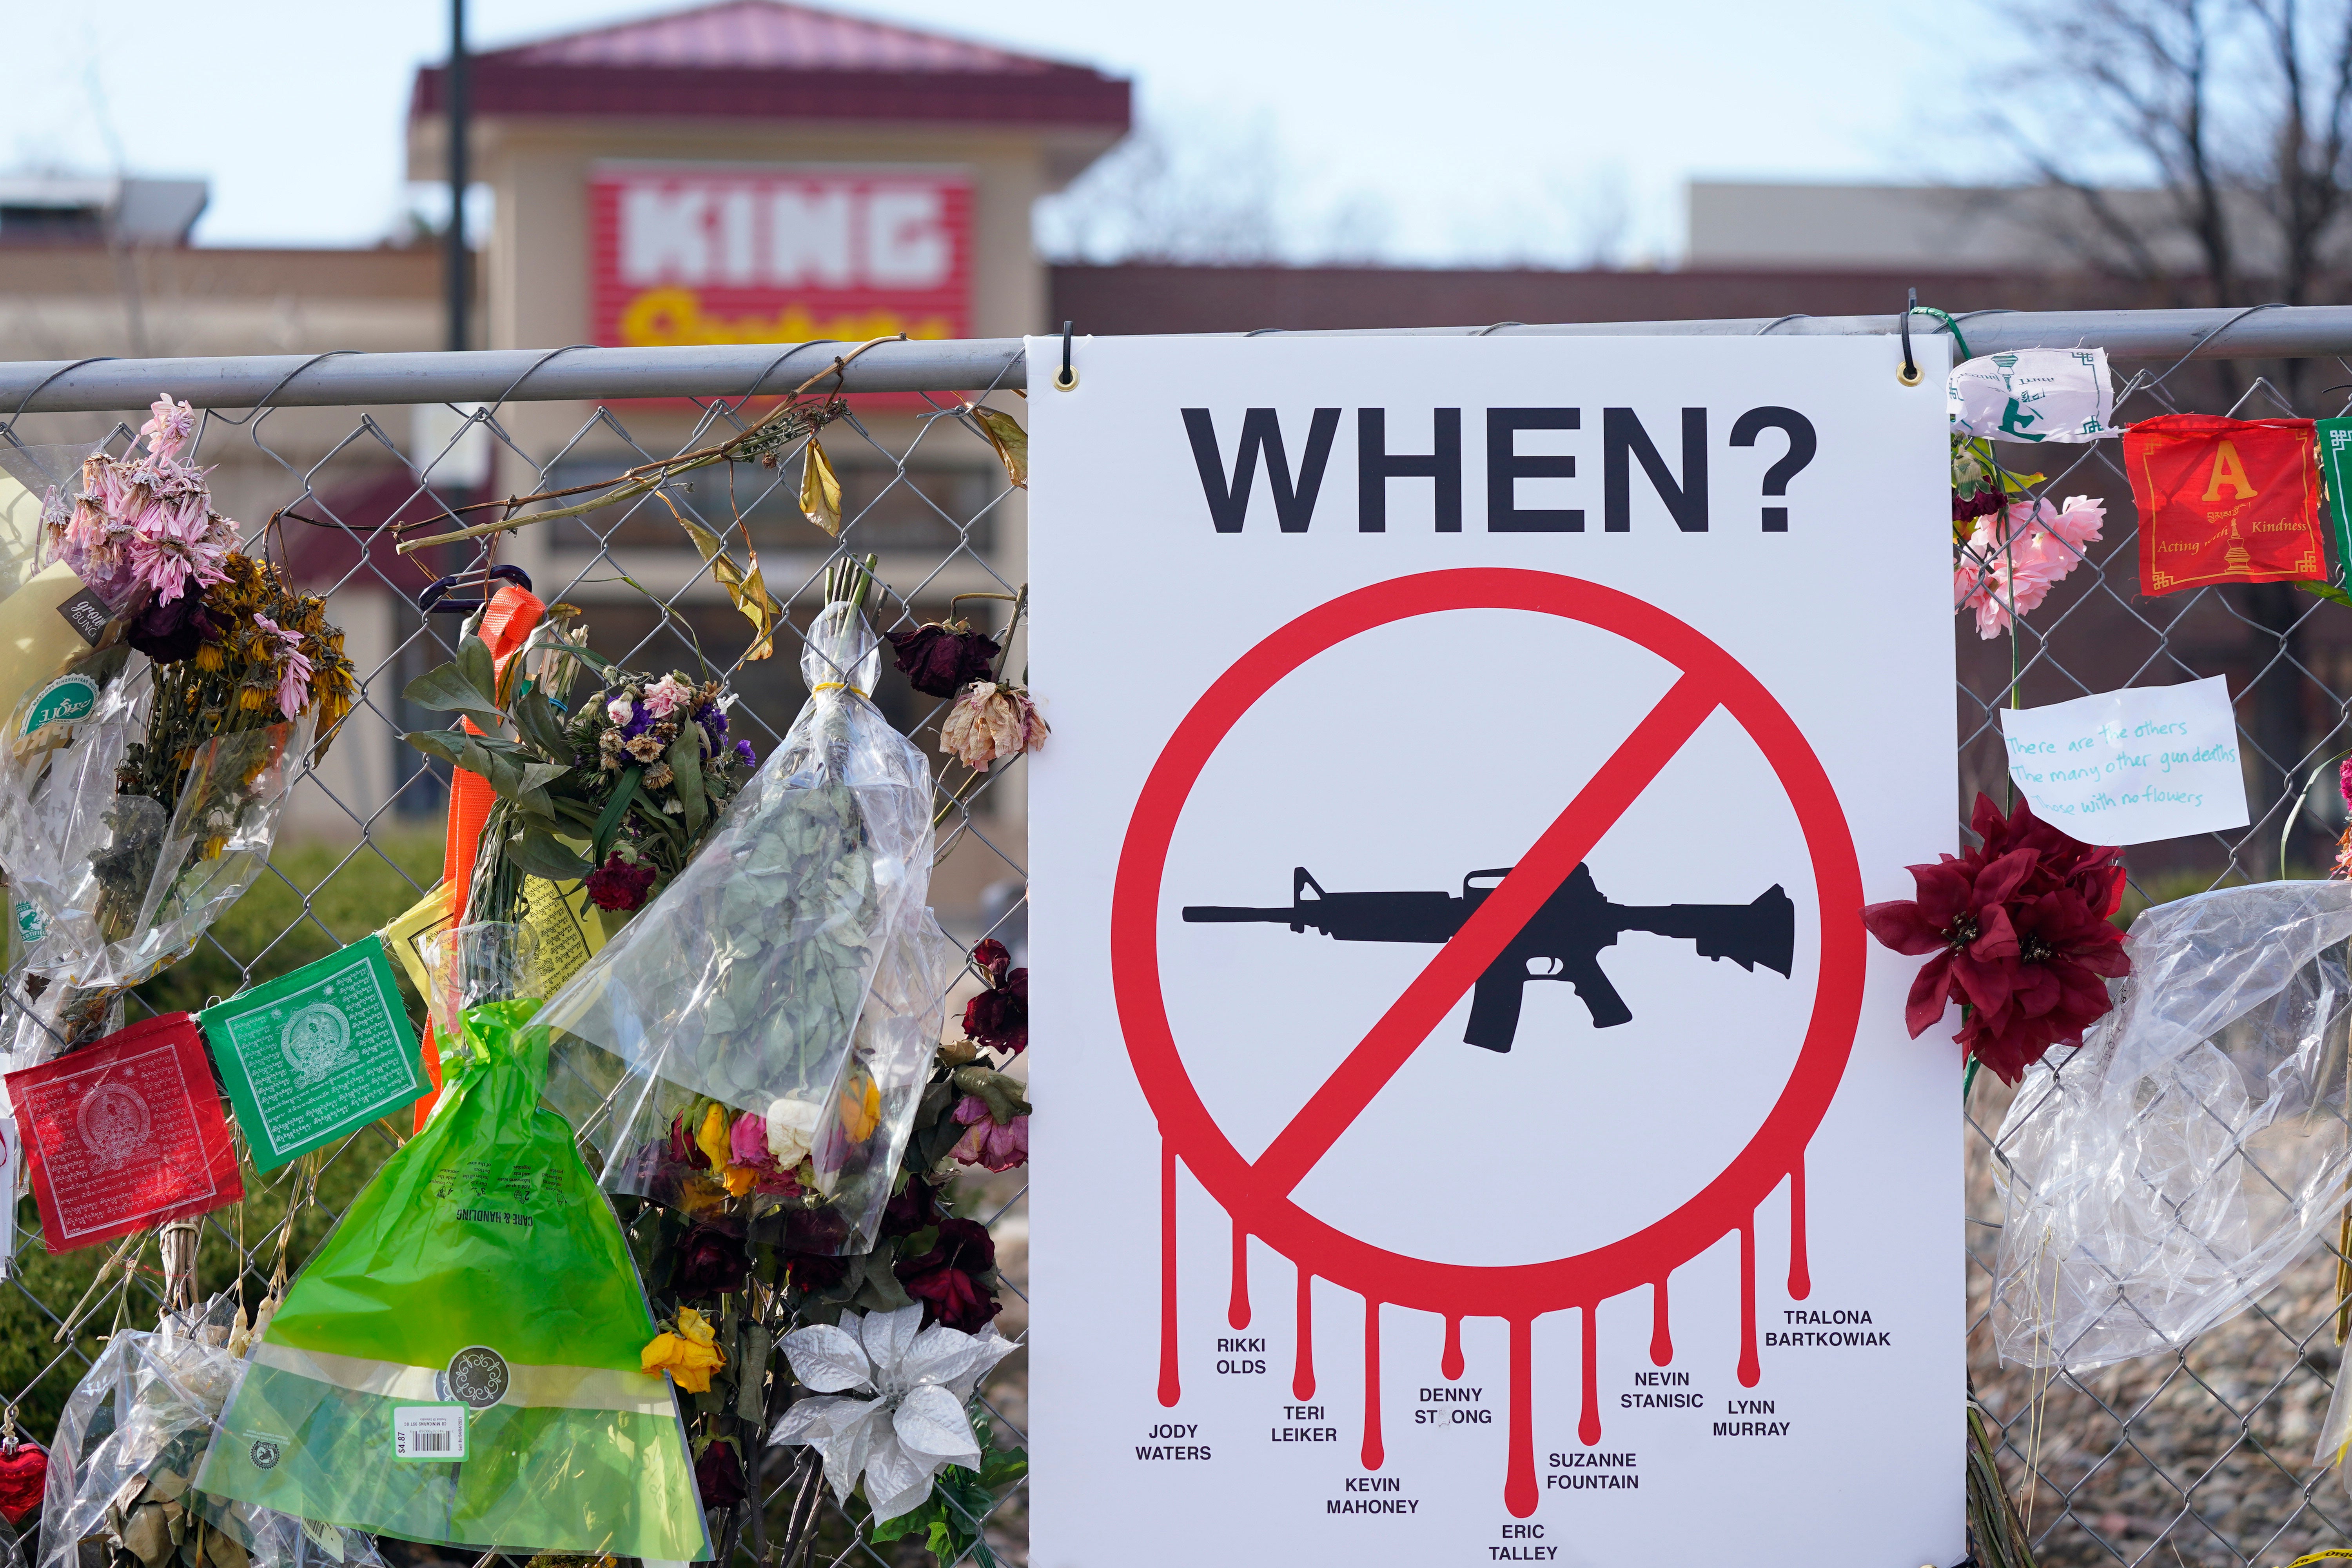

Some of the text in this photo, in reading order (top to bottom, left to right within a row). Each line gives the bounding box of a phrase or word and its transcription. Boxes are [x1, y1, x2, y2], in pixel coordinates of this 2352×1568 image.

[621, 185, 949, 289] KING
[1180, 406, 1817, 533] WHEN?
[2201, 440, 2258, 501] A
[2157, 518, 2306, 555] Acting with Kindness
[2006, 720, 2187, 754] There are the others
[2011, 744, 2235, 782] The many other gun deaths
[2031, 785, 2203, 815] Those with no flowers
[524, 1191, 530, 1201] 2
[456, 1209, 534, 1227] CARE & HANDLING
[1784, 1310, 1872, 1324] TRALONA
[1218, 1338, 1265, 1352] RIKKI
[1766, 1332, 1891, 1346] BARTKOWIAK
[1217, 1360, 1266, 1374] OLDS
[1635, 1372, 1689, 1386] NEVIN
[1420, 1388, 1482, 1402] DENNY
[1621, 1394, 1703, 1408] STANISIC
[1283, 1406, 1324, 1420] TERI
[1728, 1400, 1774, 1414] LYNN
[1415, 1410, 1491, 1424] STONG
[1149, 1424, 1198, 1439] JODY
[1272, 1428, 1337, 1441] LEIKER
[1713, 1422, 1790, 1436] MURRAY
[1135, 1446, 1211, 1460] WATERS
[1549, 1453, 1636, 1467] SUZANNE
[1346, 1478, 1399, 1492] KEVIN
[1548, 1475, 1638, 1489] FOUNTAIN
[1327, 1499, 1419, 1514] MAHONEY
[1503, 1524, 1544, 1539] ERIC
[1489, 1546, 1558, 1560] TALLEY
